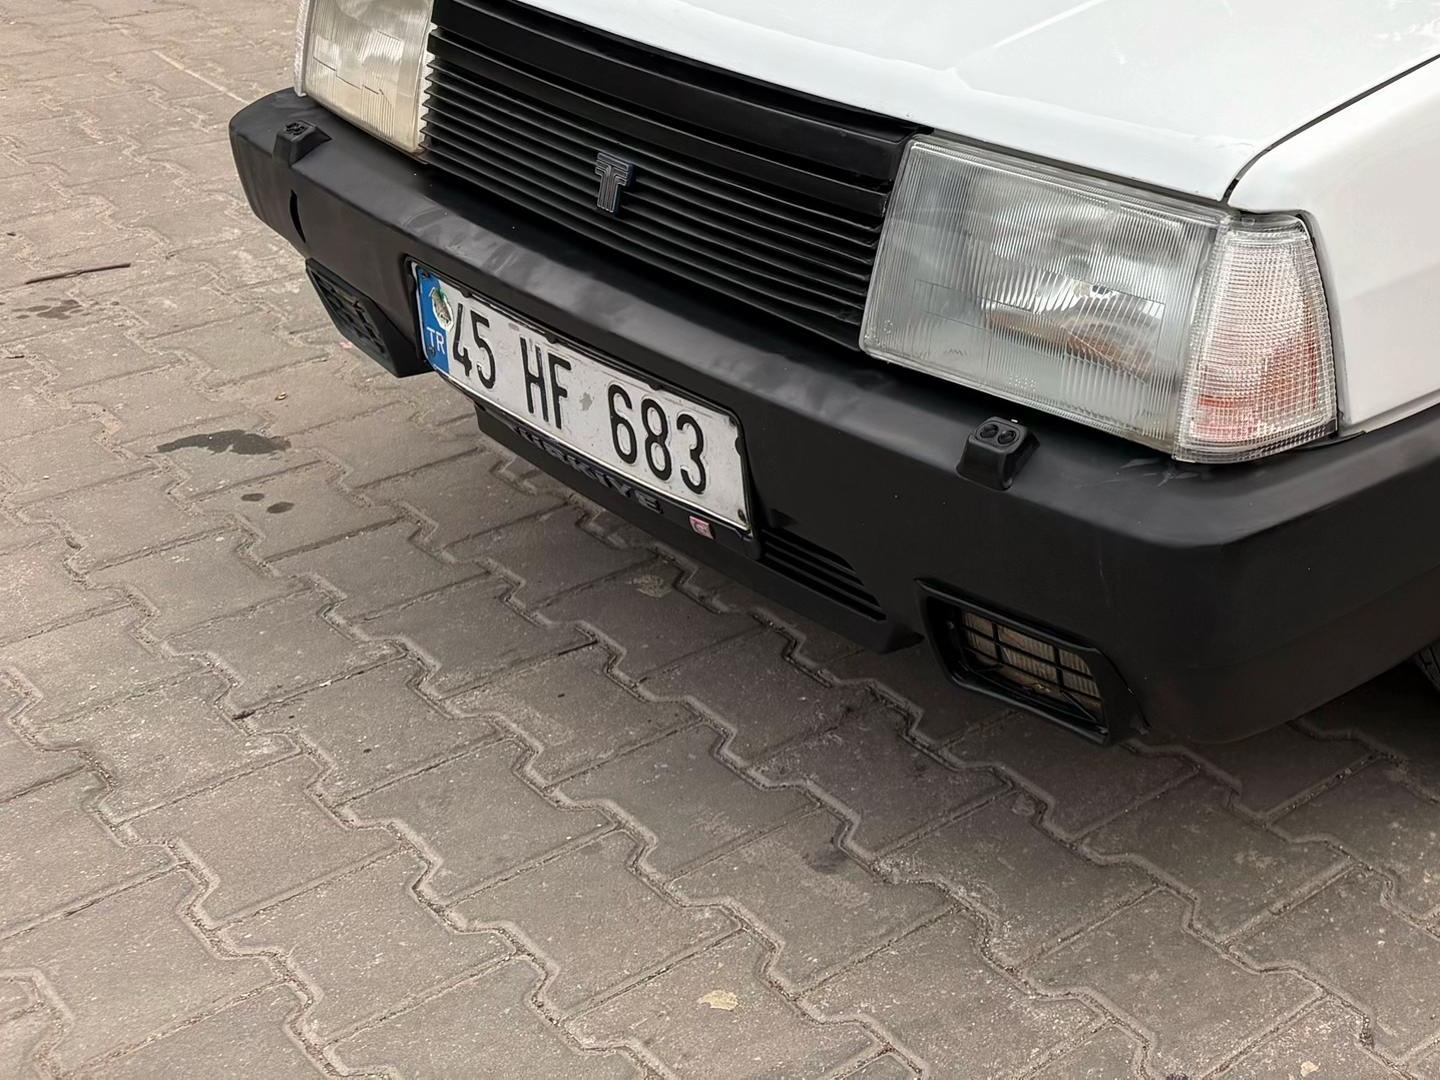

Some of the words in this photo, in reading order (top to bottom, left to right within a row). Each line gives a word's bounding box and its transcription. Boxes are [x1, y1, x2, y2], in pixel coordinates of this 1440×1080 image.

[426, 325, 446, 355] TR
[453, 303, 496, 390] 45
[519, 335, 572, 430] HF
[607, 383, 707, 495] 683
